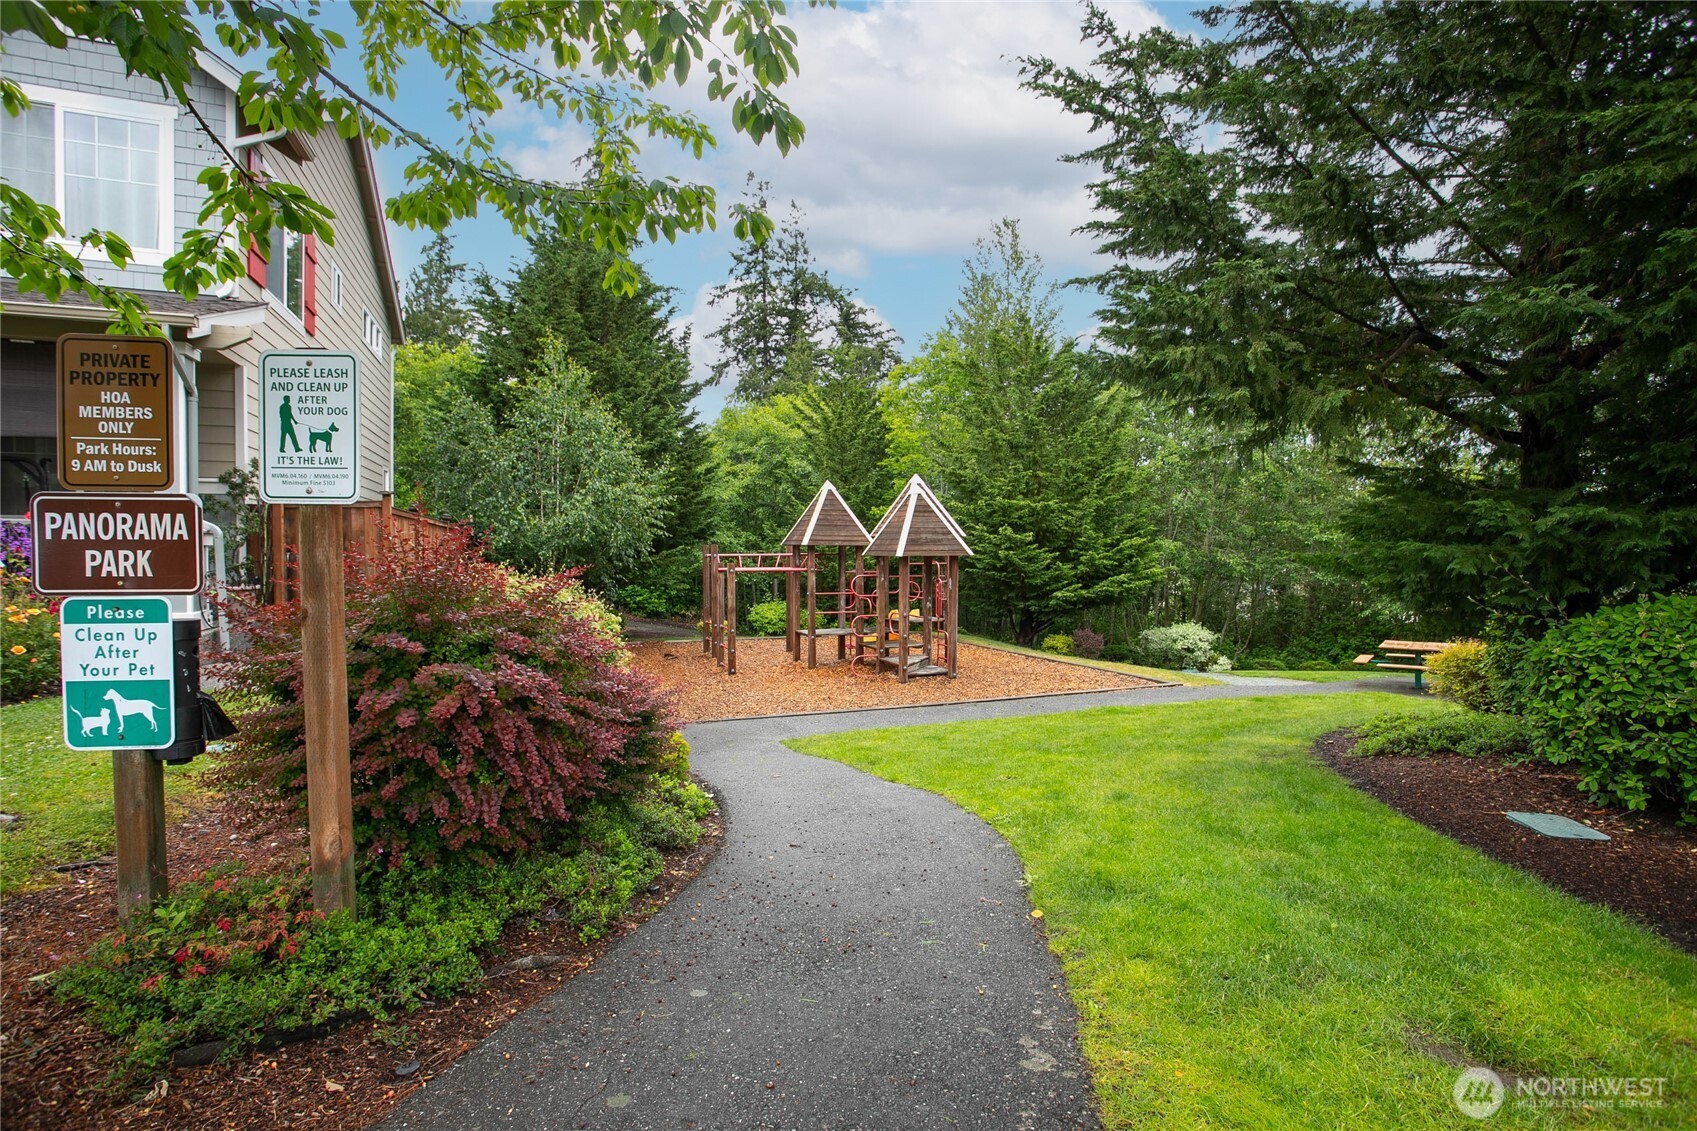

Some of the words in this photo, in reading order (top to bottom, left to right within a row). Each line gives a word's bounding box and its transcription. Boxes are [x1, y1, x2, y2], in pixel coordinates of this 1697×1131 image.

[80, 353, 150, 368] PRIVATE
[70, 371, 160, 387] PROPERTY
[270, 367, 310, 378] PLEASE
[314, 368, 348, 378] LEASH
[270, 382, 294, 392] AND
[297, 382, 330, 392] CLEAN
[334, 382, 348, 392] UP
[100, 392, 130, 404] HOA
[298, 396, 327, 404] AFTER
[79, 406, 153, 420] MEMBERS
[298, 406, 324, 416] YOUR
[327, 407, 348, 416] DOG
[98, 421, 134, 434] ONLY
[76, 442, 109, 455] Park
[112, 443, 156, 456] Hours:
[71, 459, 80, 472] 9
[84, 460, 106, 472] AM
[111, 461, 124, 472] to
[128, 460, 162, 473] Dusk
[278, 456, 294, 465] IT'S
[297, 456, 316, 465] THE
[318, 456, 343, 465] LAW!
[44, 512, 189, 540] PANORAMA
[85, 550, 154, 577] PARK
[86, 604, 145, 619] Please
[75, 627, 125, 642] Clean
[134, 628, 157, 645] Up
[94, 644, 139, 659] After
[80, 663, 119, 676] Your
[128, 663, 155, 676] Pet
